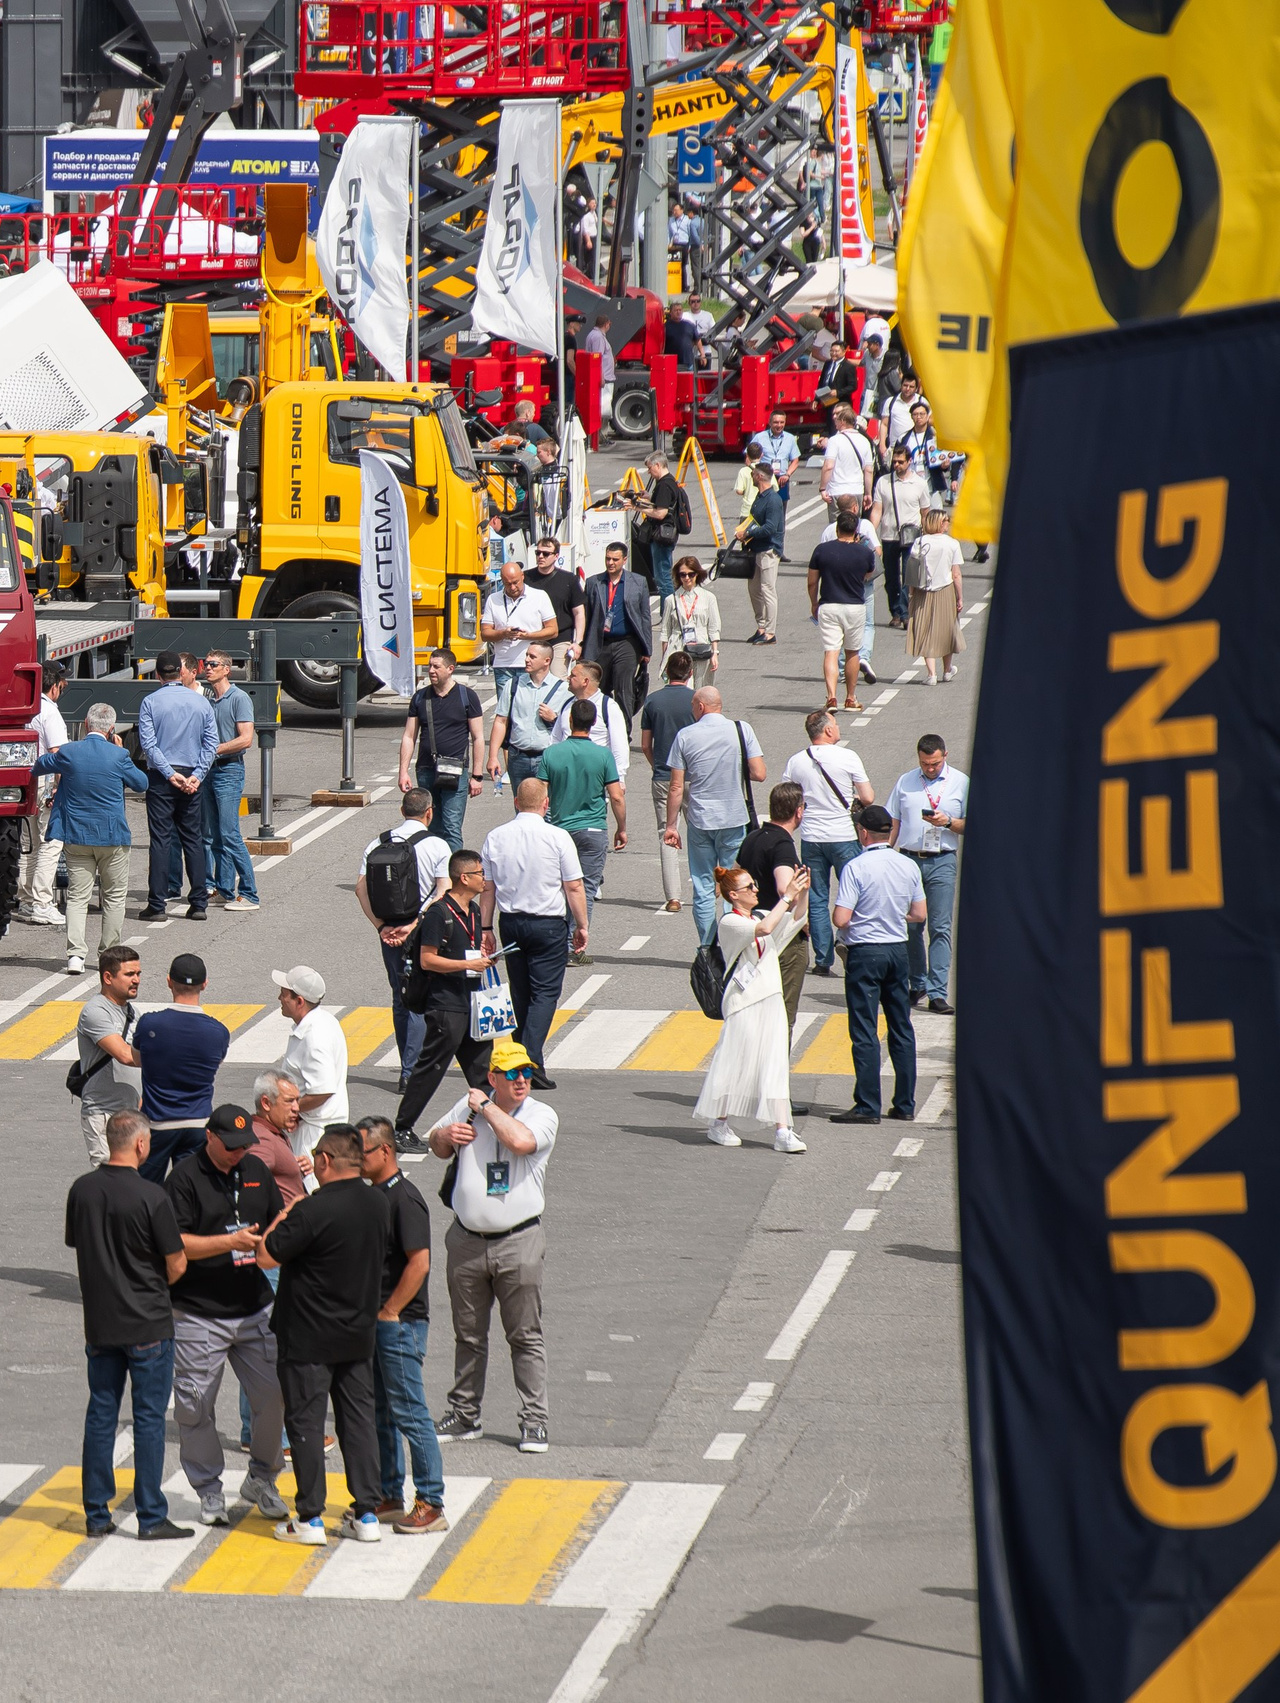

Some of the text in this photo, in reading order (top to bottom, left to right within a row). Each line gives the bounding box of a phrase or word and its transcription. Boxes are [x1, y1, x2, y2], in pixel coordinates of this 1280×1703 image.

[531, 76, 565, 86] XE140RT
[652, 91, 736, 124] HANTU
[53, 151, 85, 161] Подбор
[94, 153, 131, 162] продажа
[53, 162, 90, 171] запчасти
[97, 162, 138, 171] доставко
[194, 160, 230, 168] КАРЬЕРНЫЙ
[53, 172, 82, 181] сервис
[90, 172, 134, 181] диагности
[374, 485, 398, 632] СИСТЕМА
[1099, 476, 1278, 1530] QUNFENG
